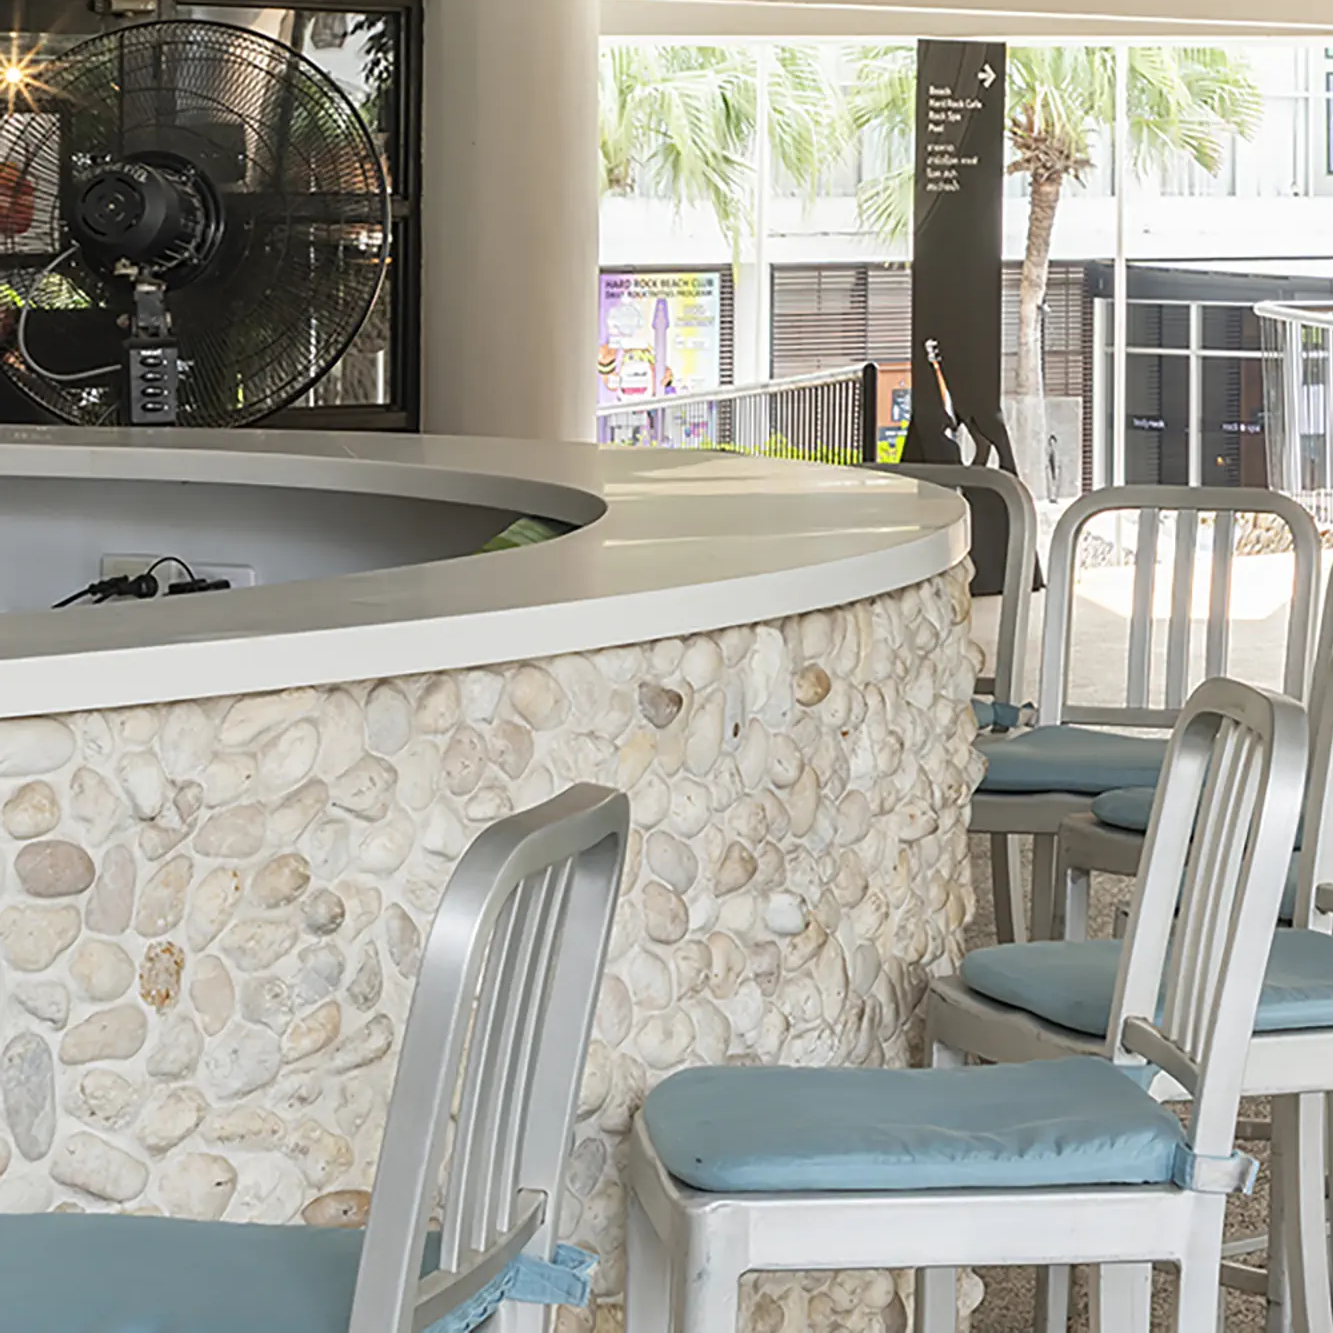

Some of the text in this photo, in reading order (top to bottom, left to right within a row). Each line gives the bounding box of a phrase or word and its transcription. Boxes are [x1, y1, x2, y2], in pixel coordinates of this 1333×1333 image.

[928, 97, 946, 108] Hard
[947, 97, 965, 108] Rock
[928, 110, 962, 123] Rock Spa
[605, 279, 631, 289] HARD
[633, 278, 657, 288] ROCK
[660, 278, 689, 287] BEACH
